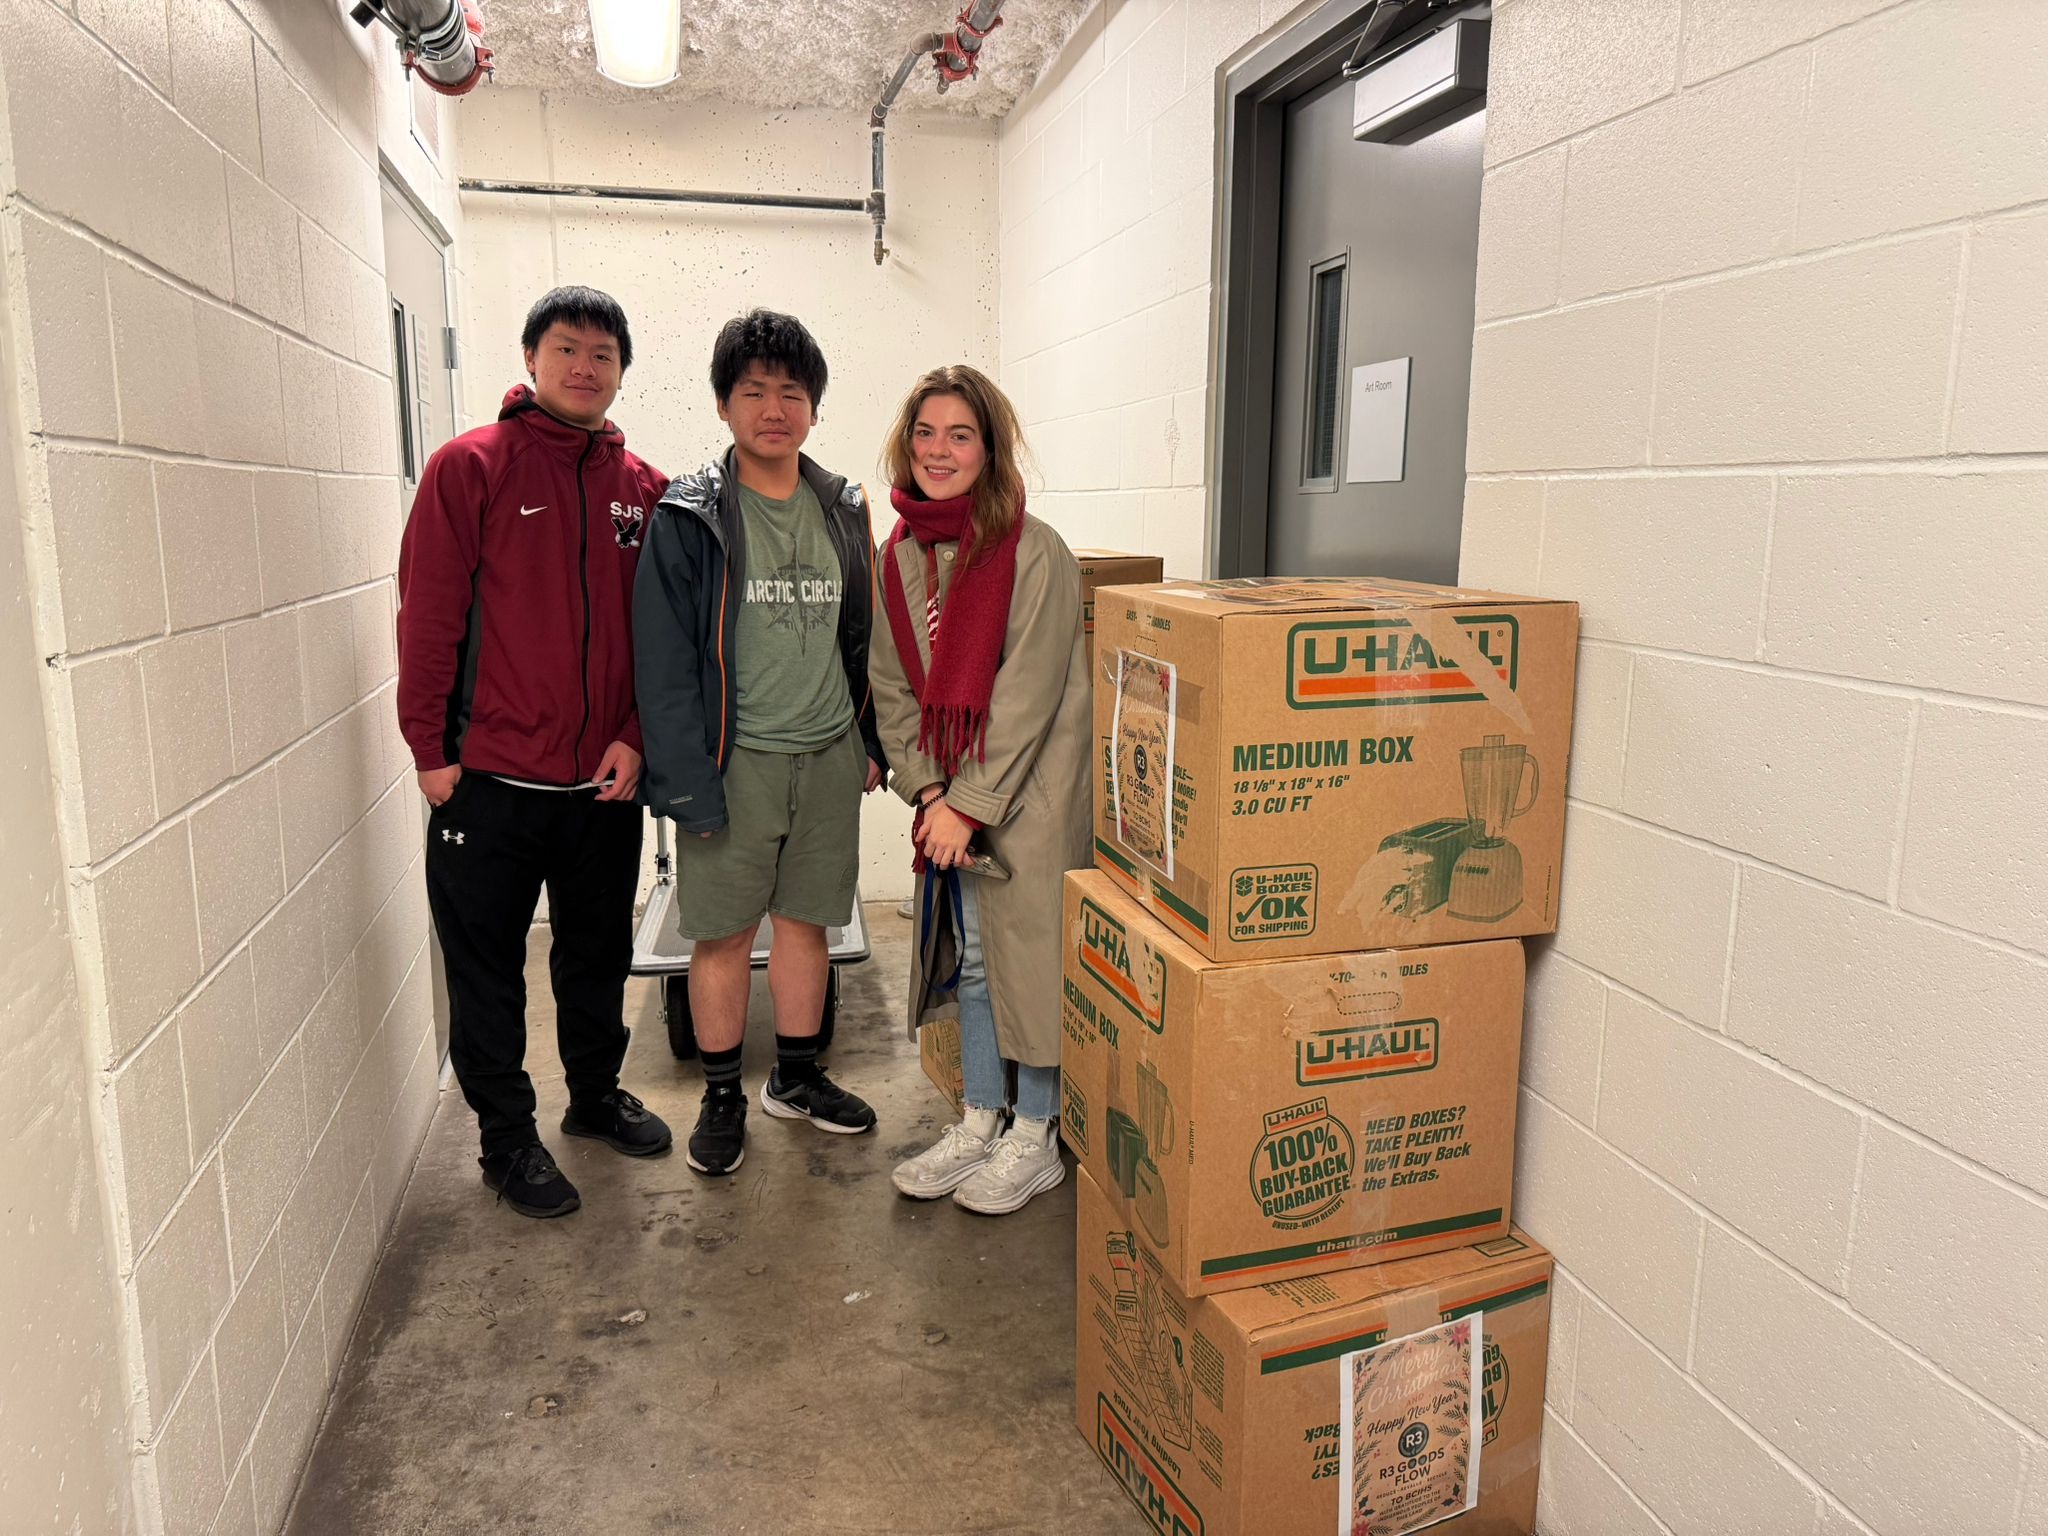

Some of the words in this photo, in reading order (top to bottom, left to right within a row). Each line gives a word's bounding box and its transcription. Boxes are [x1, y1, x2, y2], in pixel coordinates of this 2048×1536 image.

[1364, 382, 1374, 393] Art
[1375, 379, 1393, 392] Room
[610, 501, 644, 520] SJS
[746, 579, 796, 604] ARCTIC
[1137, 754, 1146, 770] R3
[1233, 740, 1348, 772] MEDIUM
[1359, 736, 1415, 765] BOX
[1134, 778, 1155, 799] GOODS
[1233, 781, 1249, 793] 18
[1277, 781, 1287, 791] x
[1291, 777, 1313, 790] 18"
[1315, 779, 1325, 789] x
[1328, 775, 1350, 788] 16"
[1133, 790, 1150, 808] FLOW
[1231, 799, 1259, 815] 3.0
[1263, 797, 1287, 814] CU
[1289, 795, 1313, 812] FT
[1256, 882, 1312, 895] BOXES
[1261, 896, 1309, 920] OK
[1235, 925, 1255, 935] FOR
[1258, 920, 1308, 934] SHIPPING
[1063, 974, 1097, 1027] MEDIUM
[1099, 1011, 1119, 1051] BOX
[1306, 1028, 1430, 1064] U-HAUL
[1071, 1106, 1086, 1138] OK
[1365, 1116, 1405, 1135] NEED
[1409, 1106, 1466, 1129] BOXES?
[1263, 1122, 1338, 1171] 100%
[1365, 1135, 1402, 1154] TAKE
[1405, 1125, 1464, 1148] PLENTY!
[1364, 1153, 1400, 1173] We'll
[1403, 1151, 1432, 1167] Buy
[1435, 1142, 1472, 1161] Back
[1260, 1152, 1348, 1198] BUY-BACK
[1362, 1176, 1386, 1192] the
[1390, 1168, 1440, 1187] Extras.
[1321, 1198, 1345, 1221] RECEIPT
[1316, 1231, 1398, 1253] uhaul.com
[1384, 1347, 1441, 1385] Merry
[1368, 1359, 1460, 1412] Christmas
[1113, 1389, 1132, 1421] Truck
[1406, 1393, 1425, 1406] AND
[1367, 1415, 1405, 1438] Happy
[1407, 1405, 1430, 1420] New
[1430, 1390, 1459, 1414] Year
[1133, 1416, 1150, 1441] Your
[1405, 1431, 1423, 1449] R3
[1151, 1435, 1182, 1480] Loading
[1379, 1465, 1395, 1480] R3
[1397, 1447, 1445, 1472] GOODS
[1395, 1464, 1431, 1487] FLOW
[1391, 1496, 1403, 1505] TO
